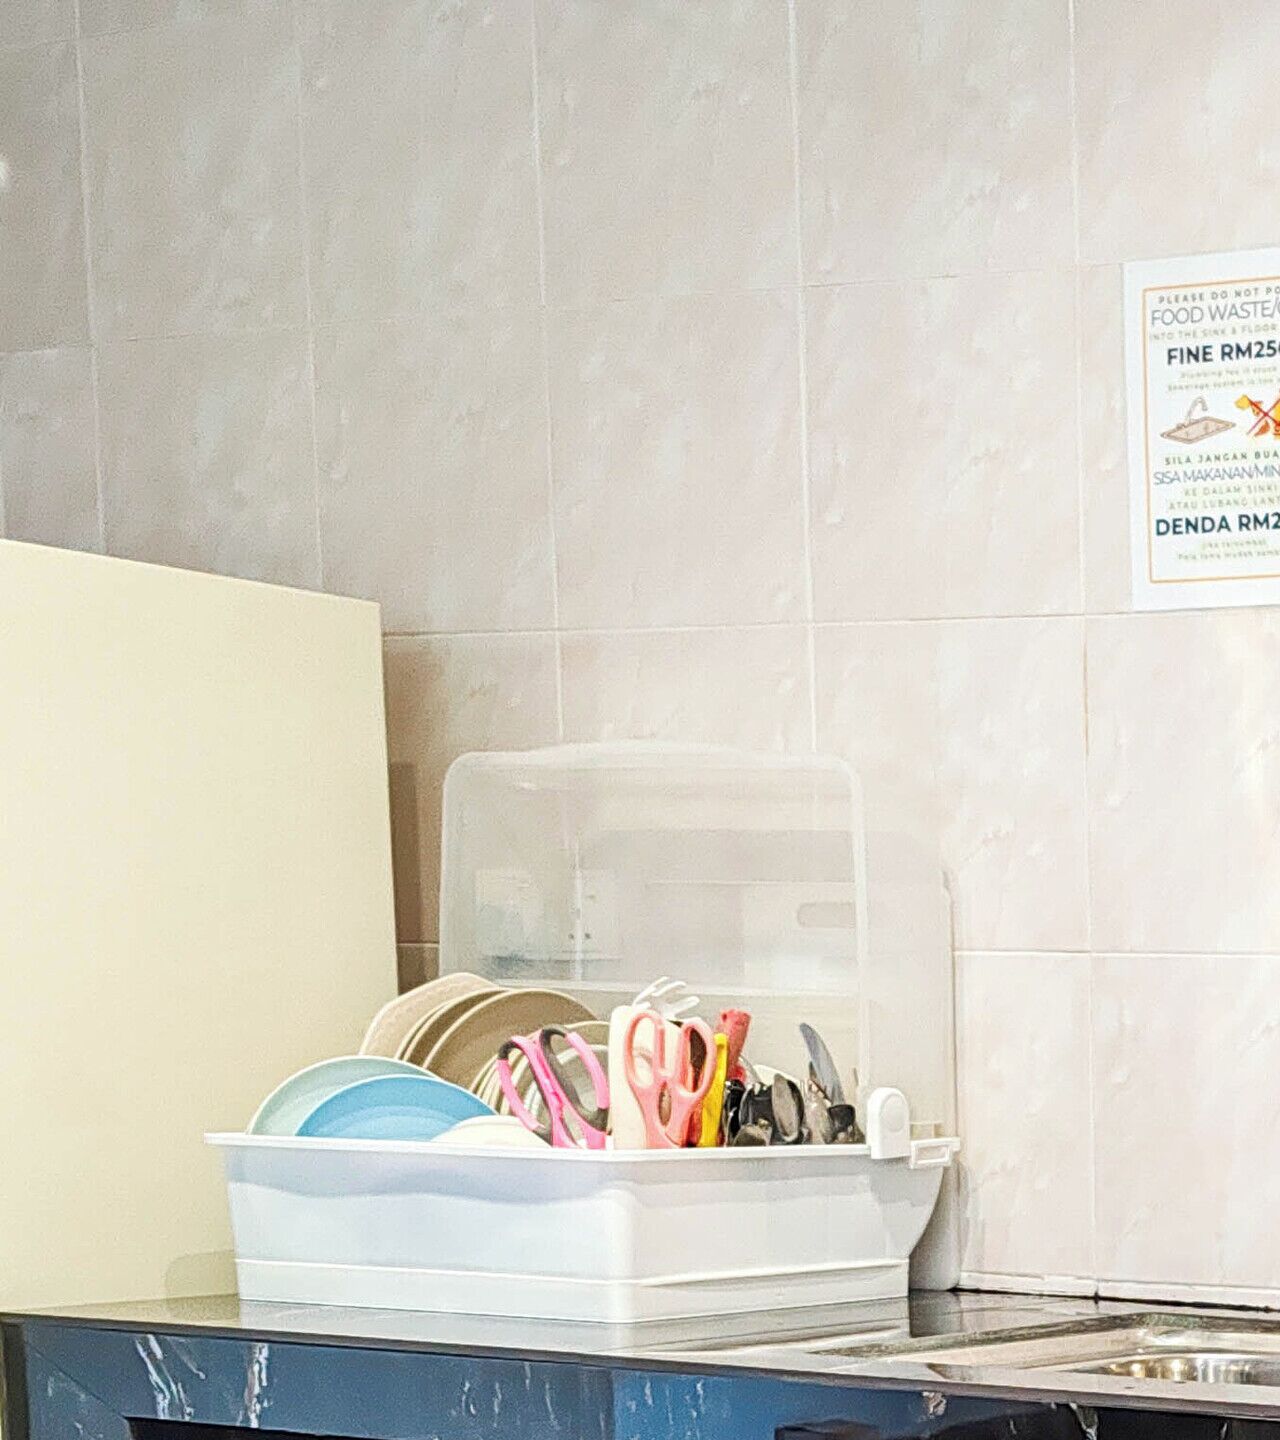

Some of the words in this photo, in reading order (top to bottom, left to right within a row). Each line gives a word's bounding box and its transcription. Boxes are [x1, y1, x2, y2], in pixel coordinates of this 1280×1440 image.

[1158, 294, 1205, 305] PLEASE
[1211, 291, 1228, 300] DO
[1234, 287, 1259, 298] NOT
[1151, 306, 1204, 327] FOOD
[1167, 344, 1214, 365] FINE
[1164, 455, 1192, 466] SILA
[1198, 451, 1248, 463] JANGAN
[1153, 470, 1181, 486] SISA
[1155, 515, 1232, 536] DENDA
